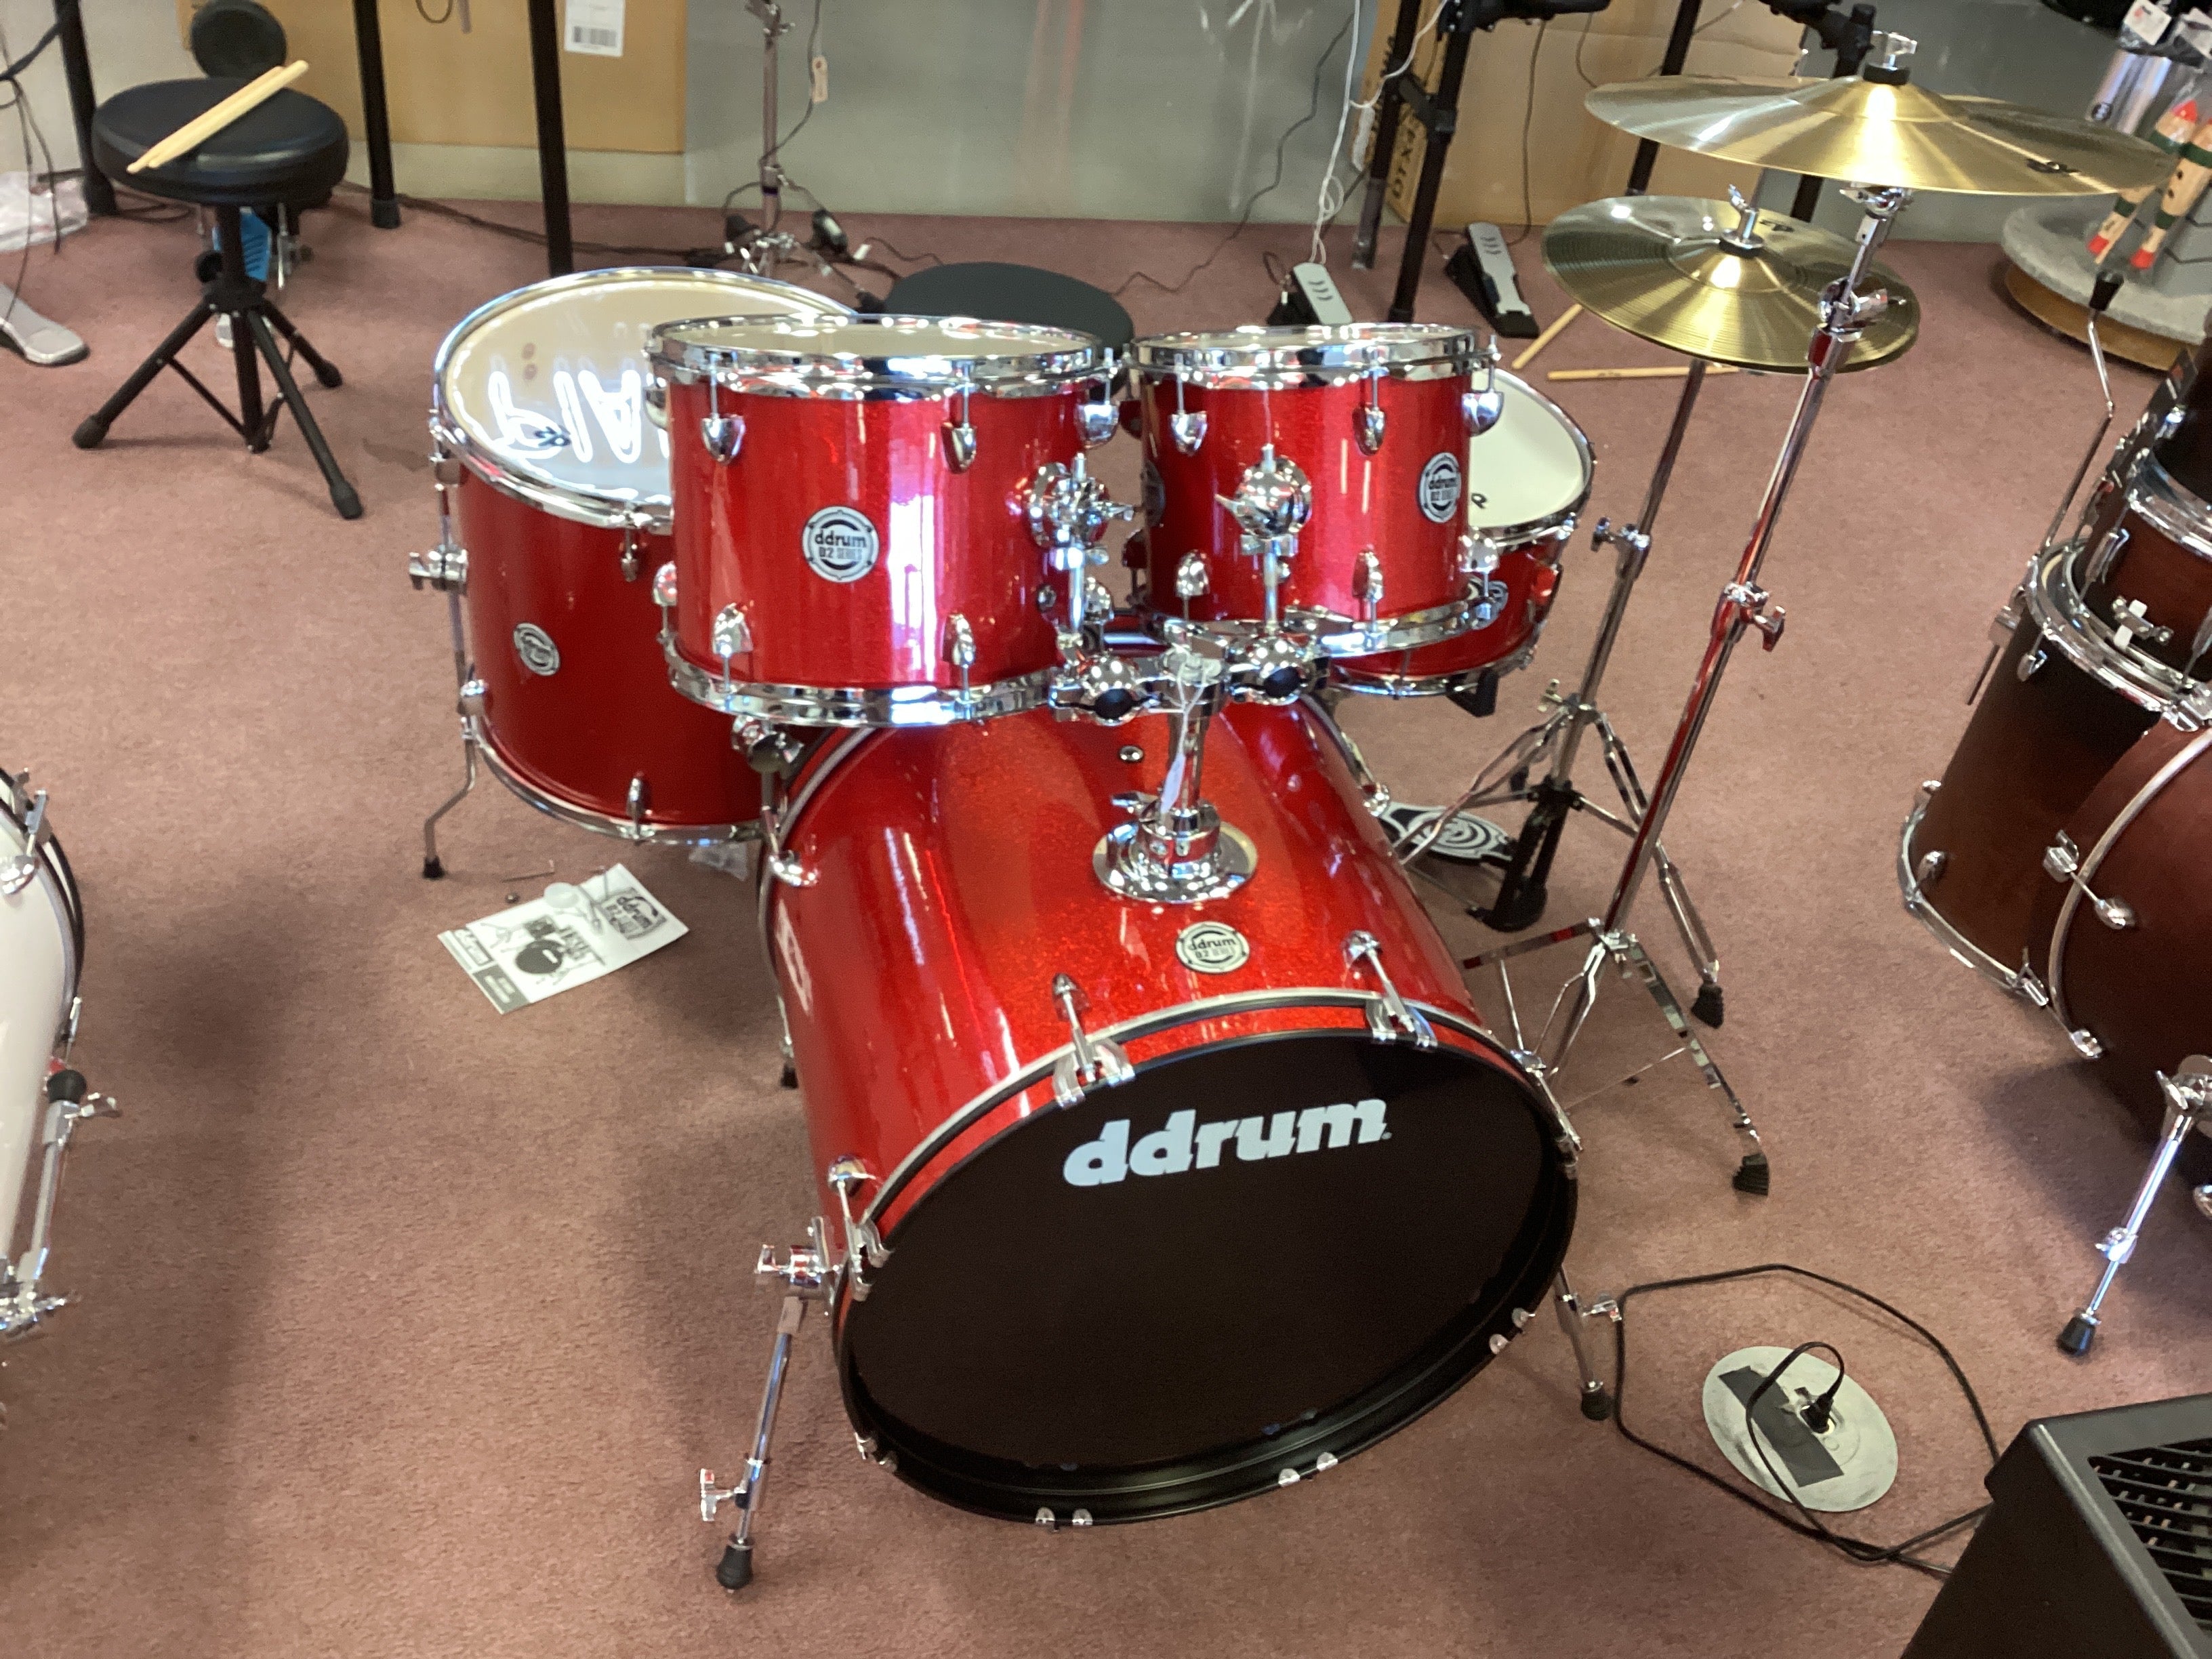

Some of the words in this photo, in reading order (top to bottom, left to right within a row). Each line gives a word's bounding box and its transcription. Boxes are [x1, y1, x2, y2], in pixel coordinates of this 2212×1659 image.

[815, 529, 867, 548] ddrum
[1188, 938, 1236, 950] ddrum
[1063, 1099, 1387, 1186] ddrum
